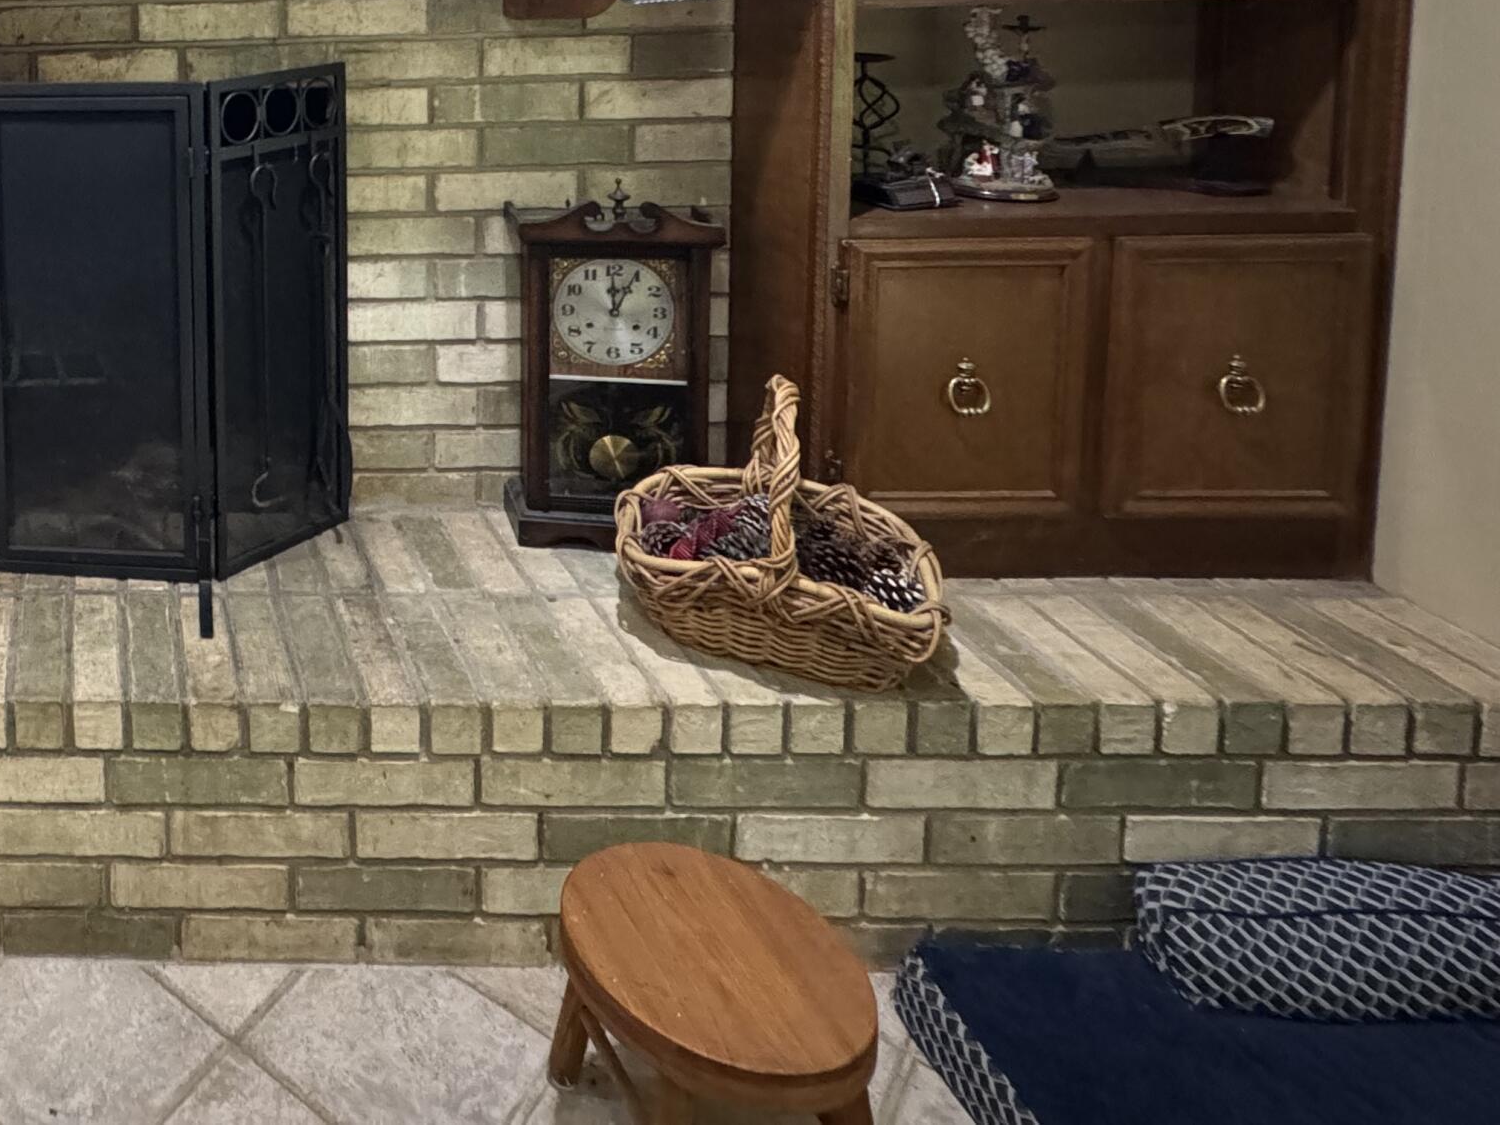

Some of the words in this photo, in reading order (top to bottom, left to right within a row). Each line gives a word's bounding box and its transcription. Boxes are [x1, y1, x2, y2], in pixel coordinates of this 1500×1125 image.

[584, 269, 597, 281] 11
[606, 264, 623, 277] 12
[567, 284, 582, 296] 10
[647, 285, 661, 298] 2
[561, 303, 575, 317] 9
[653, 306, 667, 320] 3
[567, 325, 582, 337] 8
[646, 326, 658, 339] 4
[583, 340, 596, 353] 7
[606, 346, 620, 359] 6
[629, 342, 644, 355] 5
